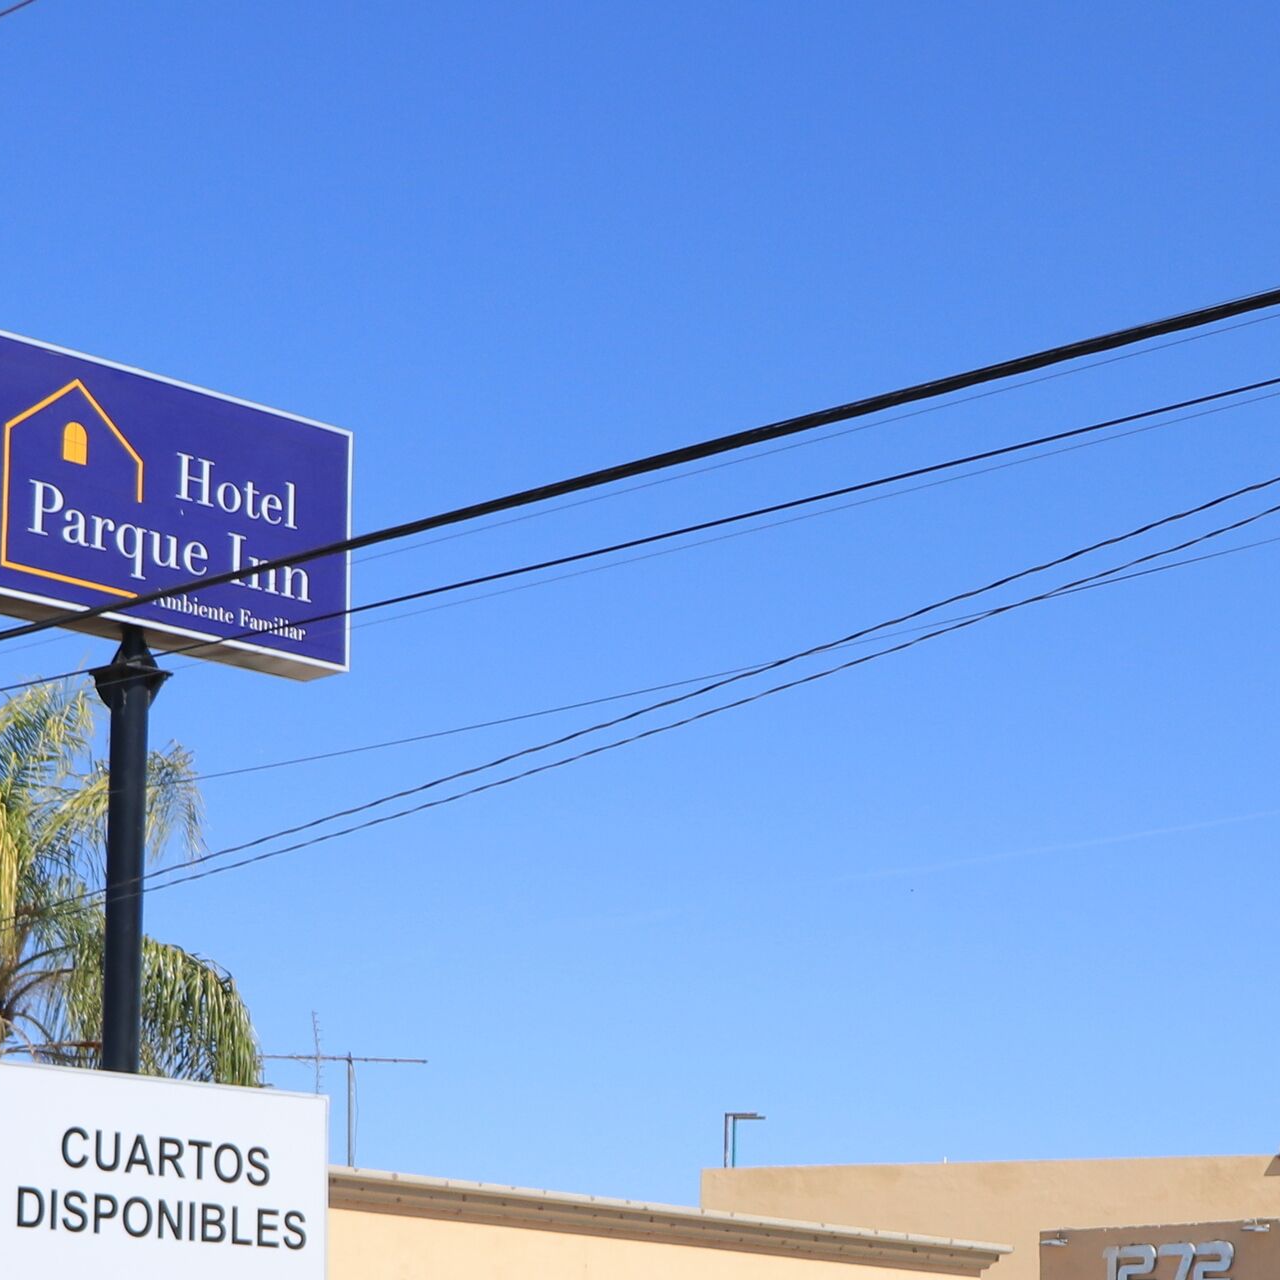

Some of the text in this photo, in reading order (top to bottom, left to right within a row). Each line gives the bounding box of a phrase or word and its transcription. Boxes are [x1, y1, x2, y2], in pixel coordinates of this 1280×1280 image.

[175, 451, 299, 530] Hotel
[26, 478, 313, 604] Parque Inn
[239, 607, 307, 642] Familiar
[61, 1126, 271, 1187] CUARTOS
[16, 1186, 307, 1250] DISPONIBLES
